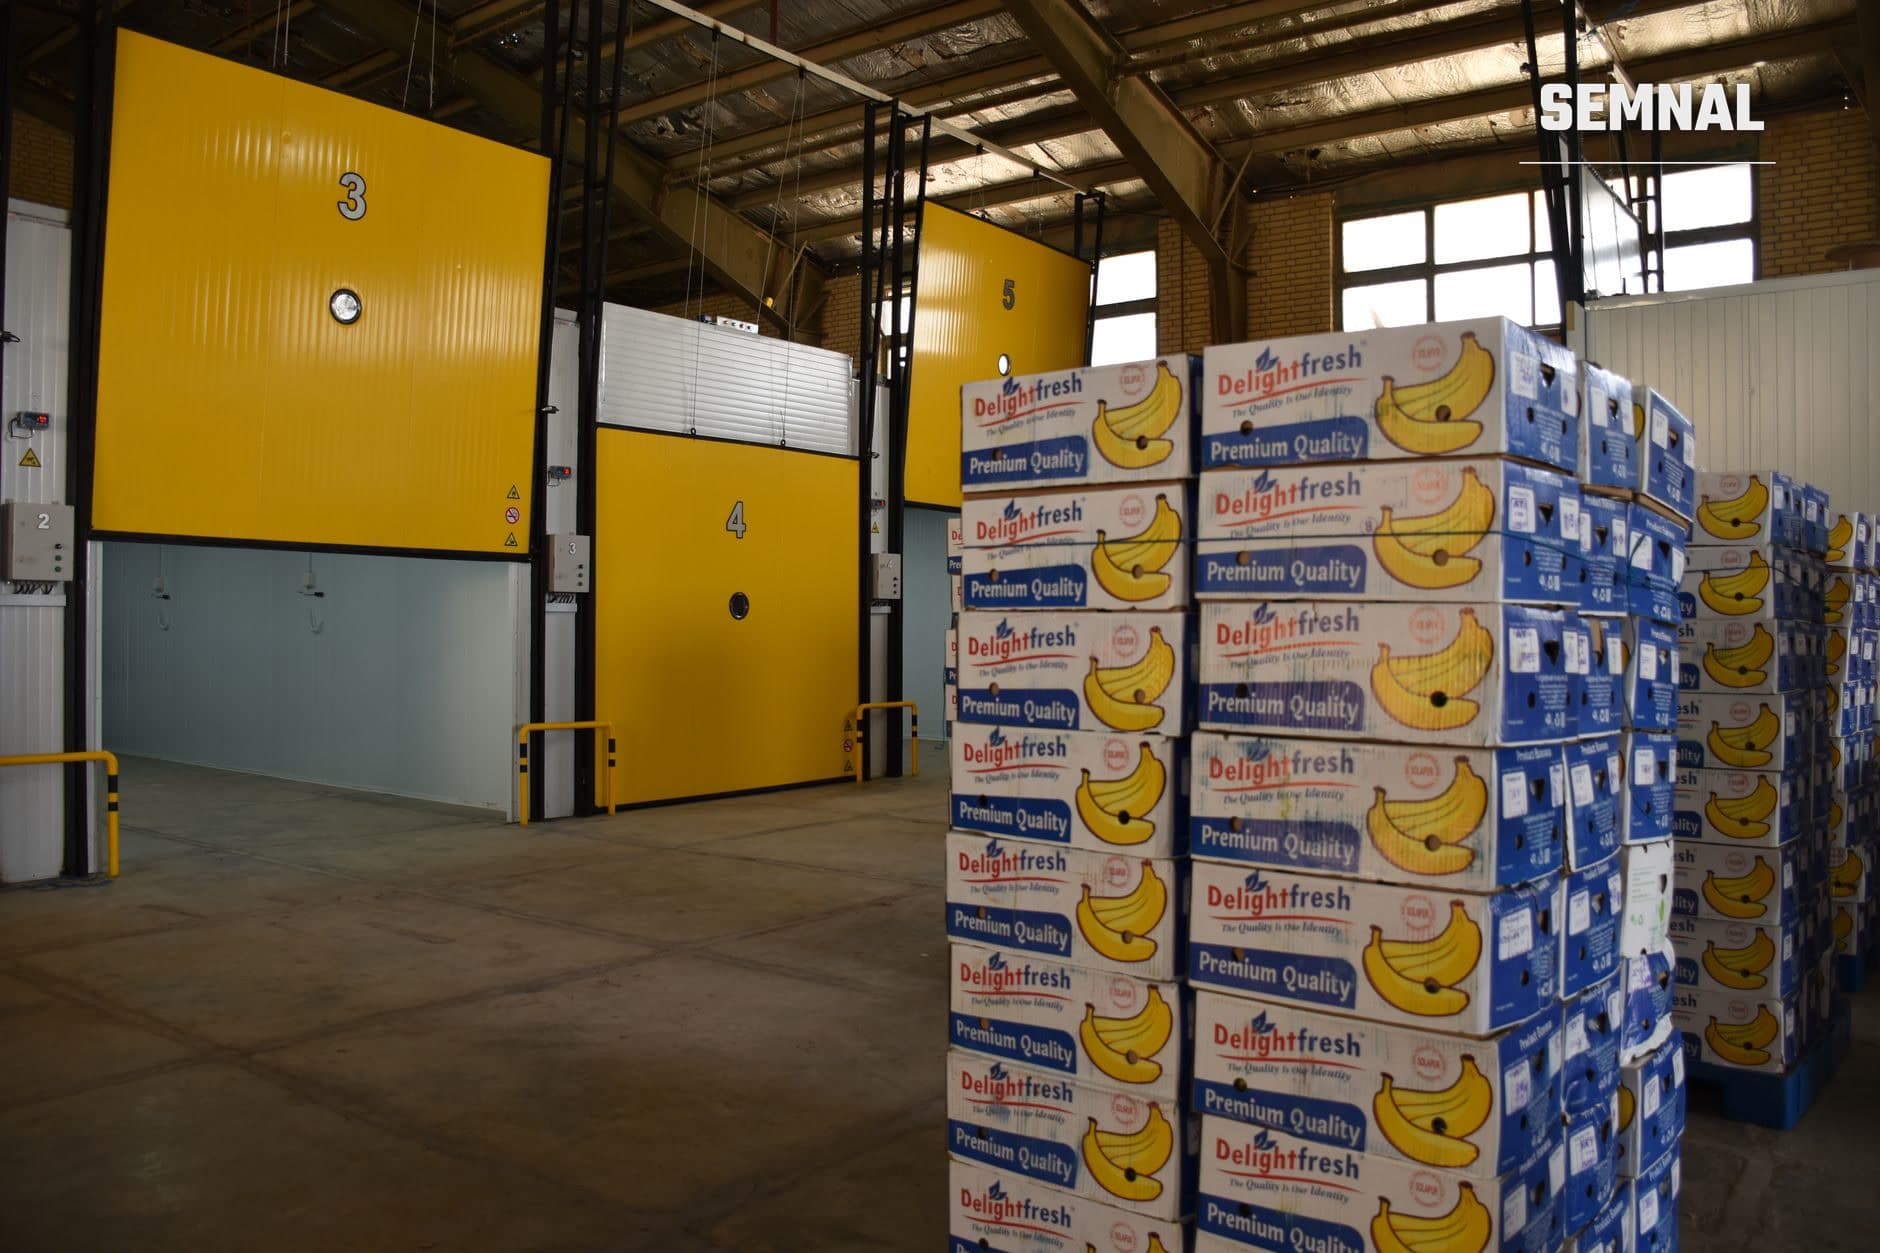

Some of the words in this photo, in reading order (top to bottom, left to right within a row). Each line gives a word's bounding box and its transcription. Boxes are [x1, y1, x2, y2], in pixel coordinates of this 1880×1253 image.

[337, 172, 367, 221] 3
[1002, 278, 1015, 311] 5
[1218, 344, 1362, 396] Delightfresh
[975, 372, 1083, 420] Delightfresh
[1248, 400, 1283, 415] Quality
[1312, 386, 1352, 399] Identity
[970, 453, 1027, 475] Premium
[1031, 449, 1085, 473] Quality
[1211, 438, 1288, 461] Premium
[1294, 431, 1363, 458] Quality
[1216, 471, 1361, 516] Delightfresh
[37, 513, 50, 529] 2
[725, 500, 746, 539] 4
[976, 500, 1083, 544] Delightfresh
[1312, 513, 1351, 523] Identity
[568, 542, 577, 555] 3
[971, 576, 1028, 598] Premium
[1031, 574, 1084, 601] Quality
[1207, 559, 1285, 582] Premium
[1291, 558, 1361, 588] Quality
[968, 624, 1076, 660] Delightfresh
[1217, 606, 1360, 648] Delightfresh
[1311, 648, 1351, 659] Identity
[962, 695, 1020, 718] Premium
[1024, 700, 1076, 726] Quality
[1208, 691, 1284, 714] Premium
[1290, 694, 1359, 725] Quality
[964, 735, 1067, 766] Delightfresh
[1208, 747, 1354, 784] Delightfresh
[1239, 791, 1274, 804] Quality
[1304, 788, 1344, 801] Identity
[960, 802, 1013, 825] Premium
[1016, 809, 1068, 837] Quality
[1672, 819, 1699, 835] ality
[1202, 825, 1278, 852] Premium
[1284, 833, 1355, 862] Quality
[959, 850, 1067, 878] Delightfresh
[1207, 884, 1351, 916] Delightfresh
[955, 911, 1011, 936] Premium
[1014, 921, 1068, 951] Quality
[1239, 923, 1273, 934] Quality
[1303, 922, 1342, 937] Identity
[960, 963, 1071, 991] Delightfresh
[1199, 951, 1277, 984] Premium
[1283, 965, 1351, 1002] Quality
[956, 1020, 1016, 1049] Premium
[1020, 1035, 1073, 1067] Quality
[1214, 1023, 1361, 1057] Delightfresh
[961, 1071, 1073, 1102] Delightfresh
[1245, 1063, 1279, 1075] Quality
[1311, 1065, 1352, 1081] Identity
[1205, 1088, 1284, 1125] Premium
[1290, 1109, 1360, 1148] Quality
[956, 1127, 1014, 1160] Premium
[1019, 1148, 1073, 1182] Quality
[1216, 1138, 1360, 1179] Delightfresh
[961, 1188, 1072, 1228] Delightfresh
[1246, 1180, 1280, 1191] Quality
[1310, 1186, 1349, 1204] Identity
[1207, 1202, 1284, 1242] Premium
[1290, 1224, 1359, 1253] Quality
